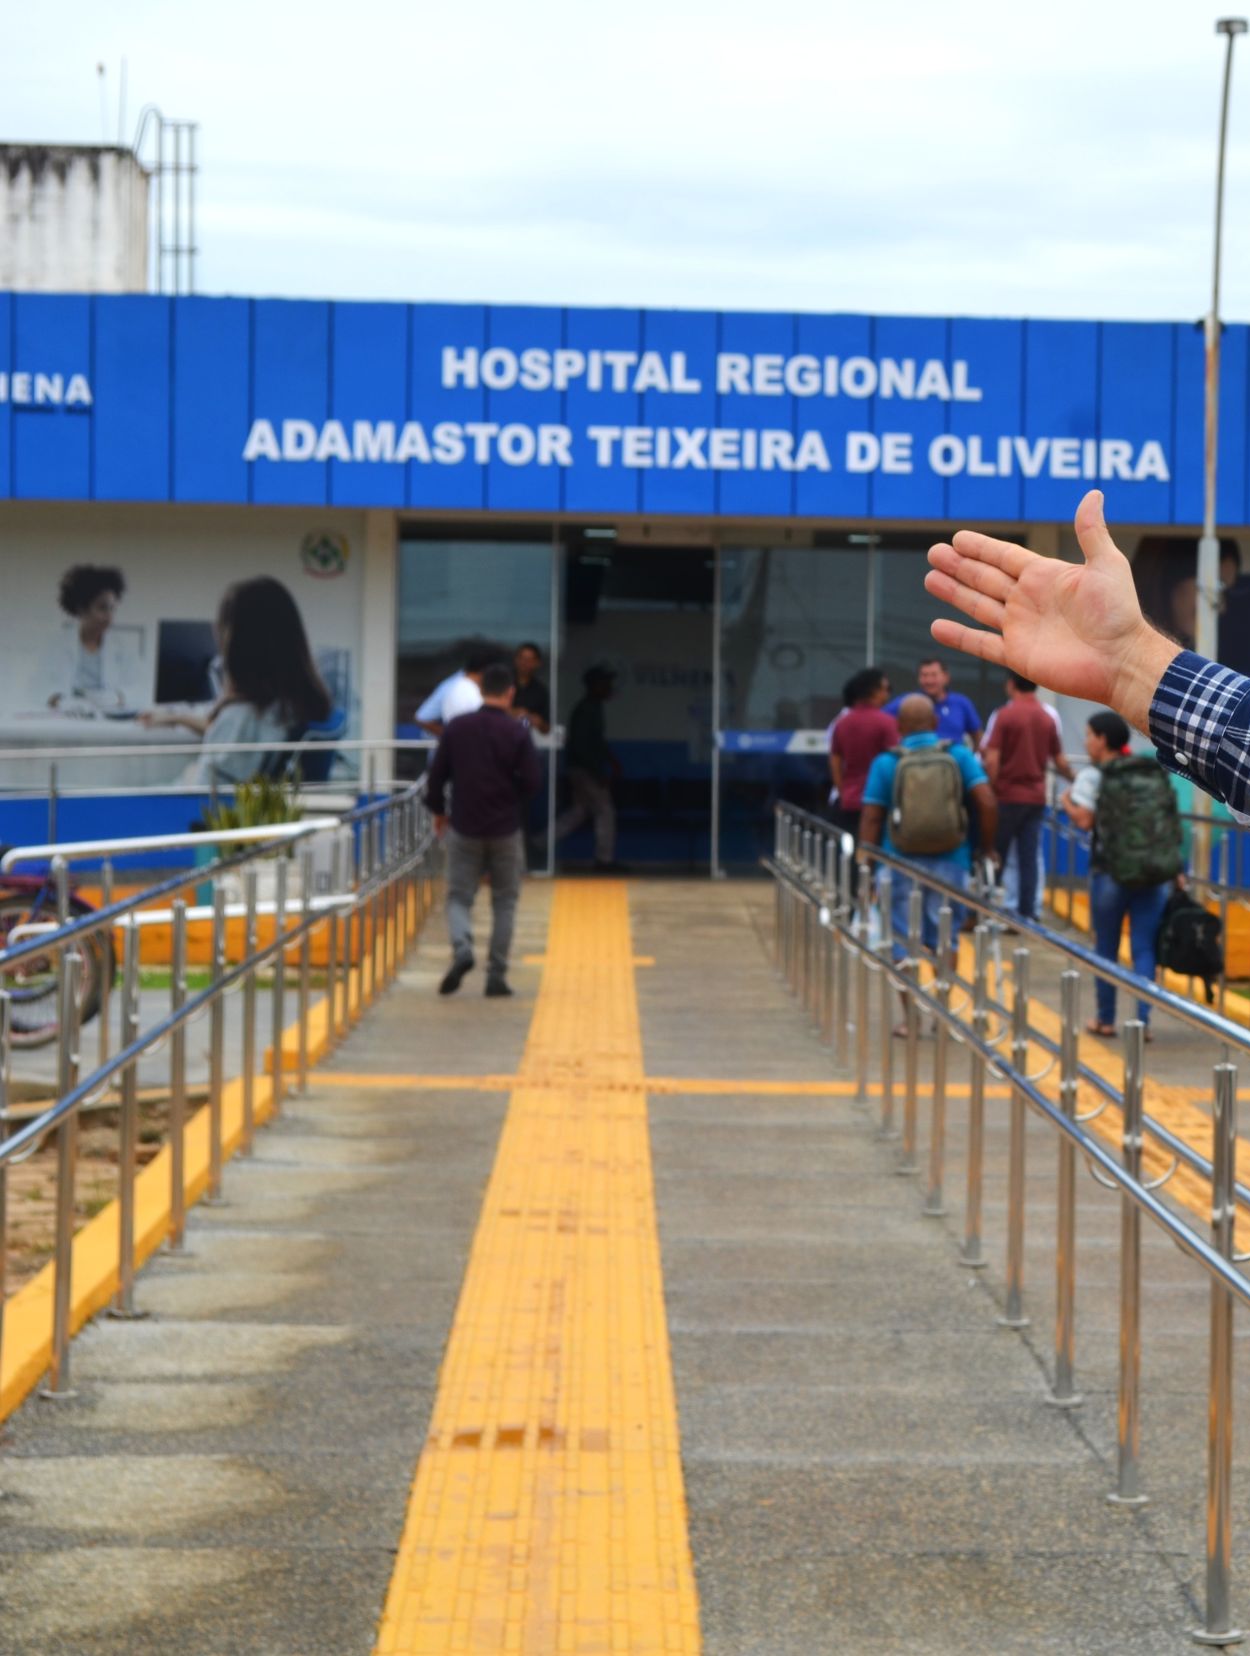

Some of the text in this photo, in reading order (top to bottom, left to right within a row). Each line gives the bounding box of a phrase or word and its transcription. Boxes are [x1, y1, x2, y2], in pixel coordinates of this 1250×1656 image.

[441, 346, 982, 402] HOSPITAL REGIONAL
[243, 418, 1170, 482] ADAMASTOR TEIXEIRA DE OLIVEIRA
